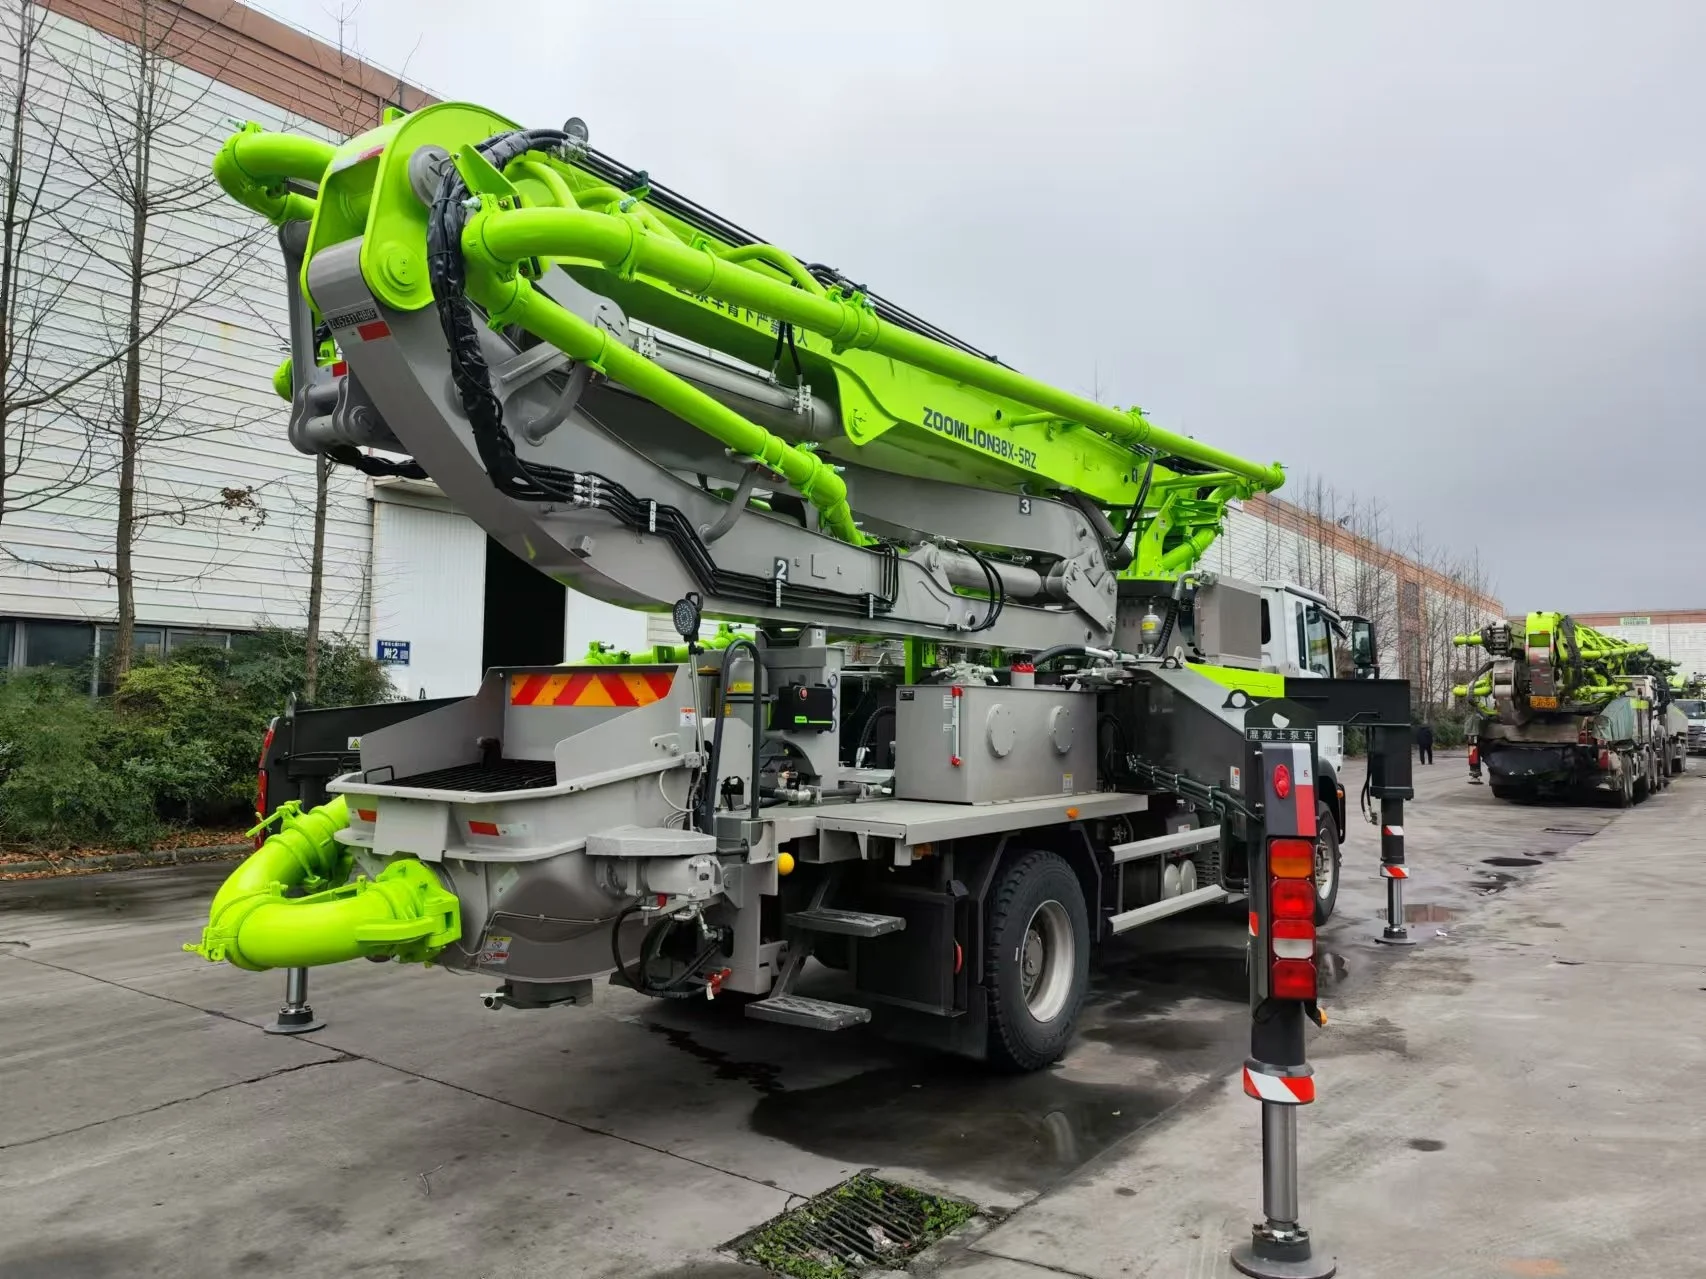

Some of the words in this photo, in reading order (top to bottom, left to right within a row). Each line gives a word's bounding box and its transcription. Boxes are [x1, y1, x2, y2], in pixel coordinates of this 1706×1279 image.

[923, 406, 1037, 470] ZOOMLION38X-5RZ
[1020, 499, 1031, 514] 3
[776, 559, 787, 580] 2
[1250, 729, 1313, 741] 混凝土泵车
